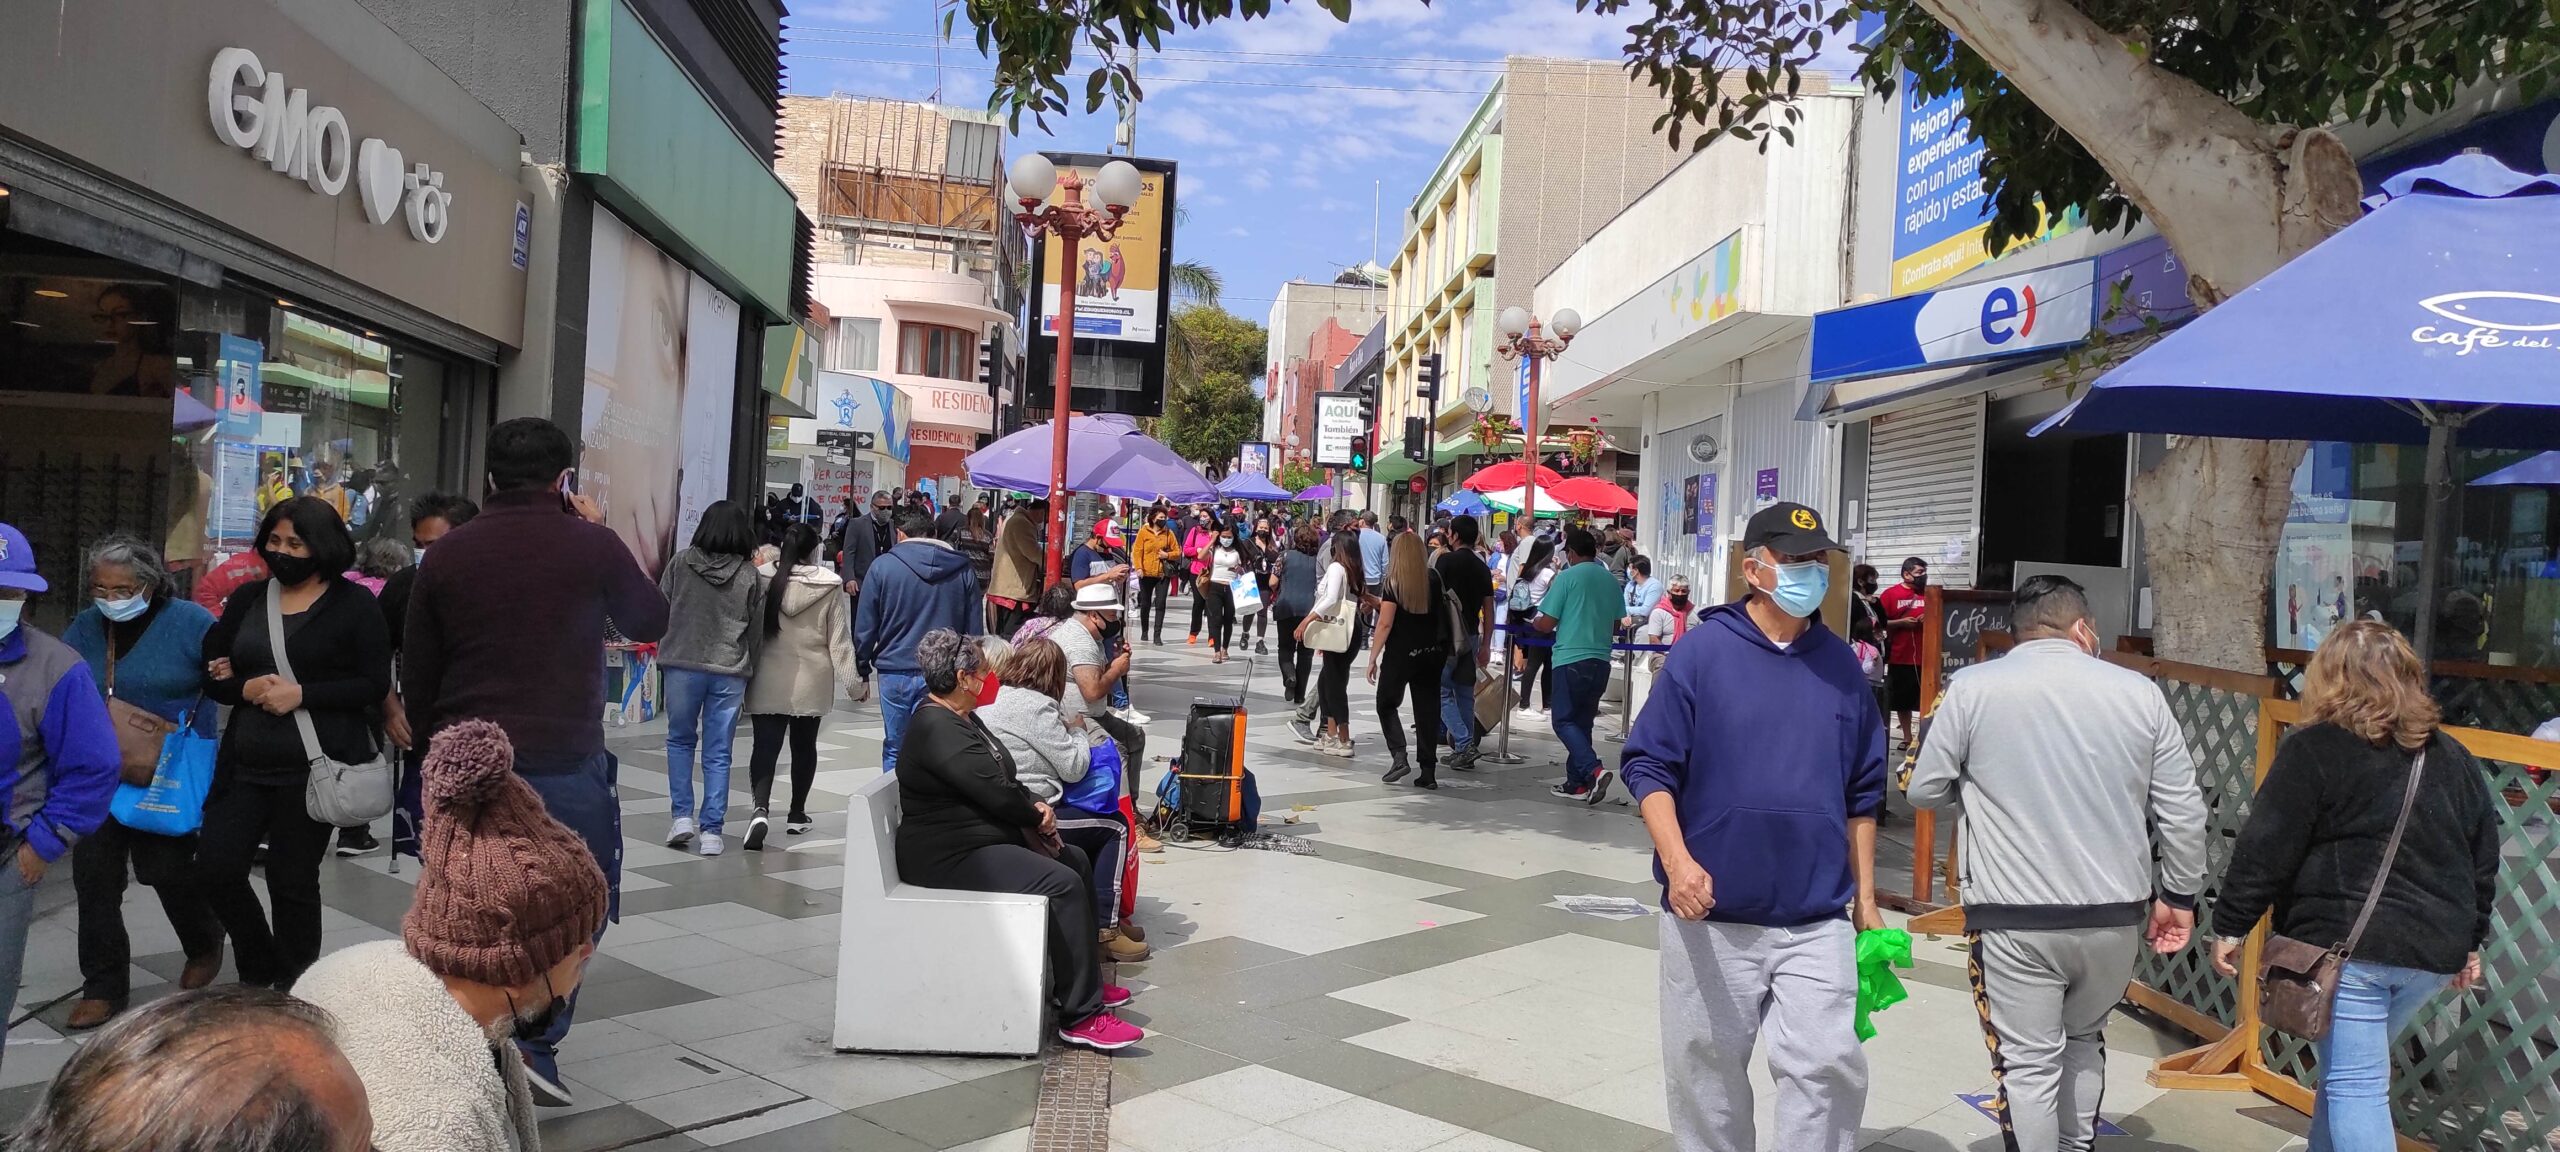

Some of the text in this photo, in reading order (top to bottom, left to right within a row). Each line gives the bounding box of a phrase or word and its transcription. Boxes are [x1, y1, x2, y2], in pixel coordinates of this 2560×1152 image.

[208, 47, 351, 195] GMO
[1910, 98, 1964, 146] Mejora tu
[1906, 149, 1983, 204] con un Intern
[1905, 200, 1941, 235] rápido
[1942, 194, 1951, 220] y
[707, 287, 728, 320] VICHY
[2412, 326, 2553, 356] Café del
[932, 390, 993, 415] RESIDENC
[1324, 403, 1358, 418] AQUÍ
[911, 428, 964, 446] RESIDENCIAL
[1946, 606, 2006, 644] Café del
